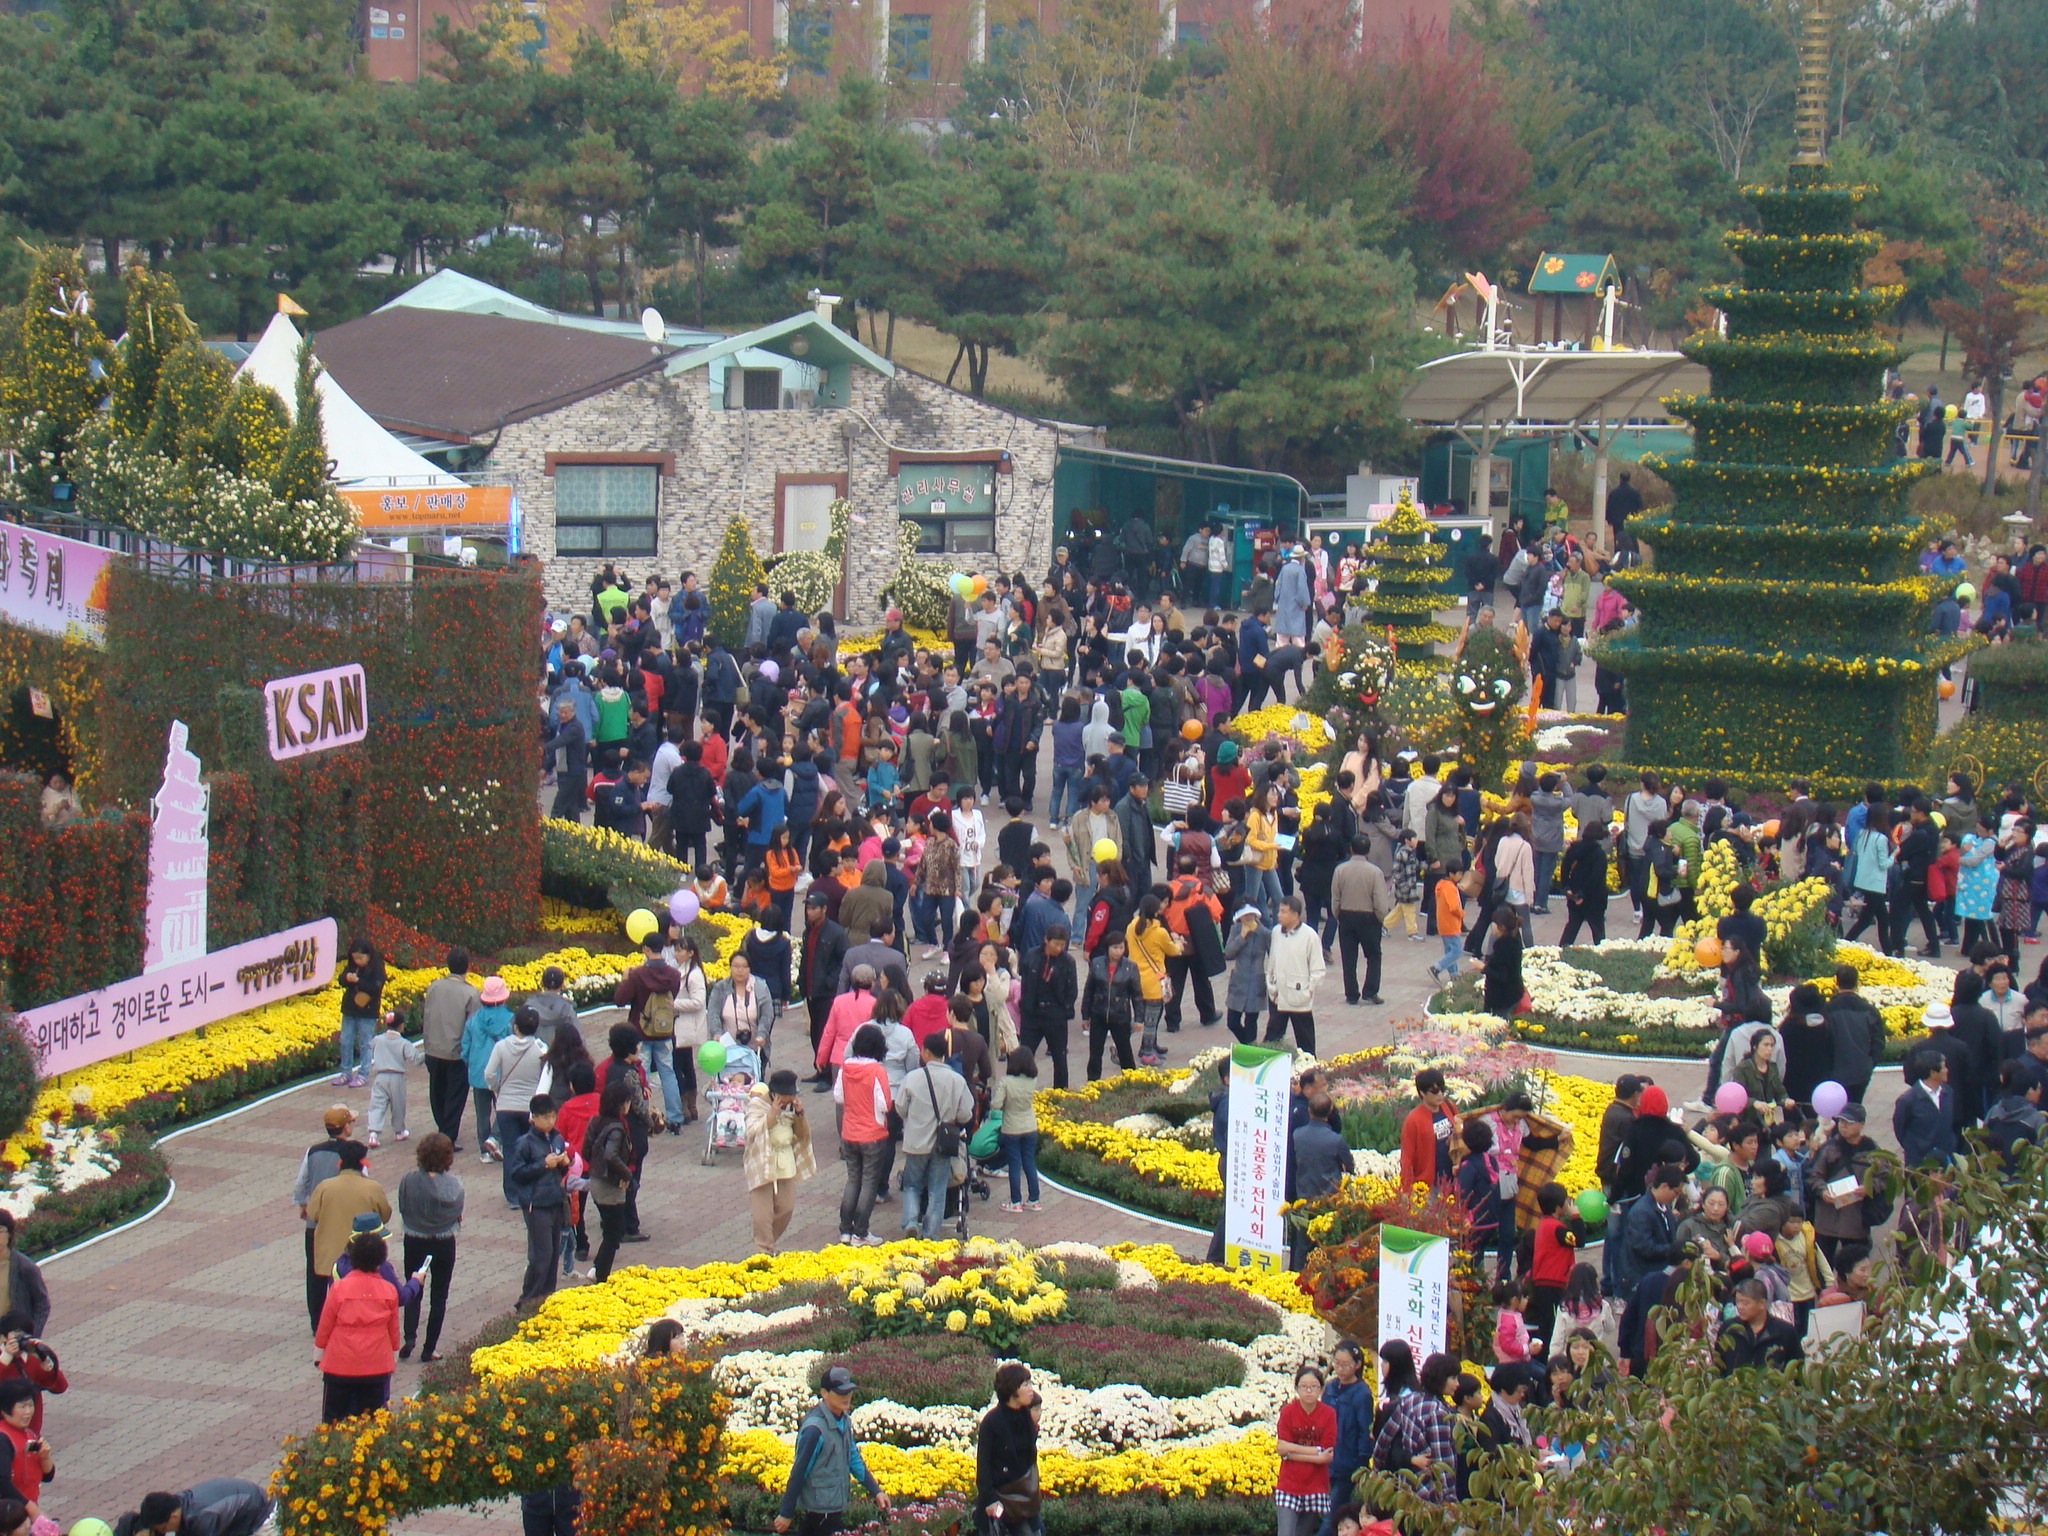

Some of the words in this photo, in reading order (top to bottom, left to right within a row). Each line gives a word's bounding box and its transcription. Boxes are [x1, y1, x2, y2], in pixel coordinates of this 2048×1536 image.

[381, 495, 409, 512] 홍보
[426, 492, 468, 510] 판매장
[902, 476, 976, 504] 관리사무실
[273, 673, 364, 750] KSAN
[38, 998, 101, 1055] 위대하고
[112, 983, 172, 1039] 경이로운
[284, 936, 320, 984] 익산
[1255, 1087, 1270, 1123] 국화
[1274, 1090, 1284, 1137] 전라북도
[1251, 1128, 1268, 1181] 신품종
[1272, 1141, 1281, 1202] 농업기술원
[1249, 1186, 1266, 1240] 전시회
[1407, 1276, 1425, 1319] 국화
[1431, 1281, 1441, 1336] 전라북도
[1406, 1324, 1423, 1380] 신품
